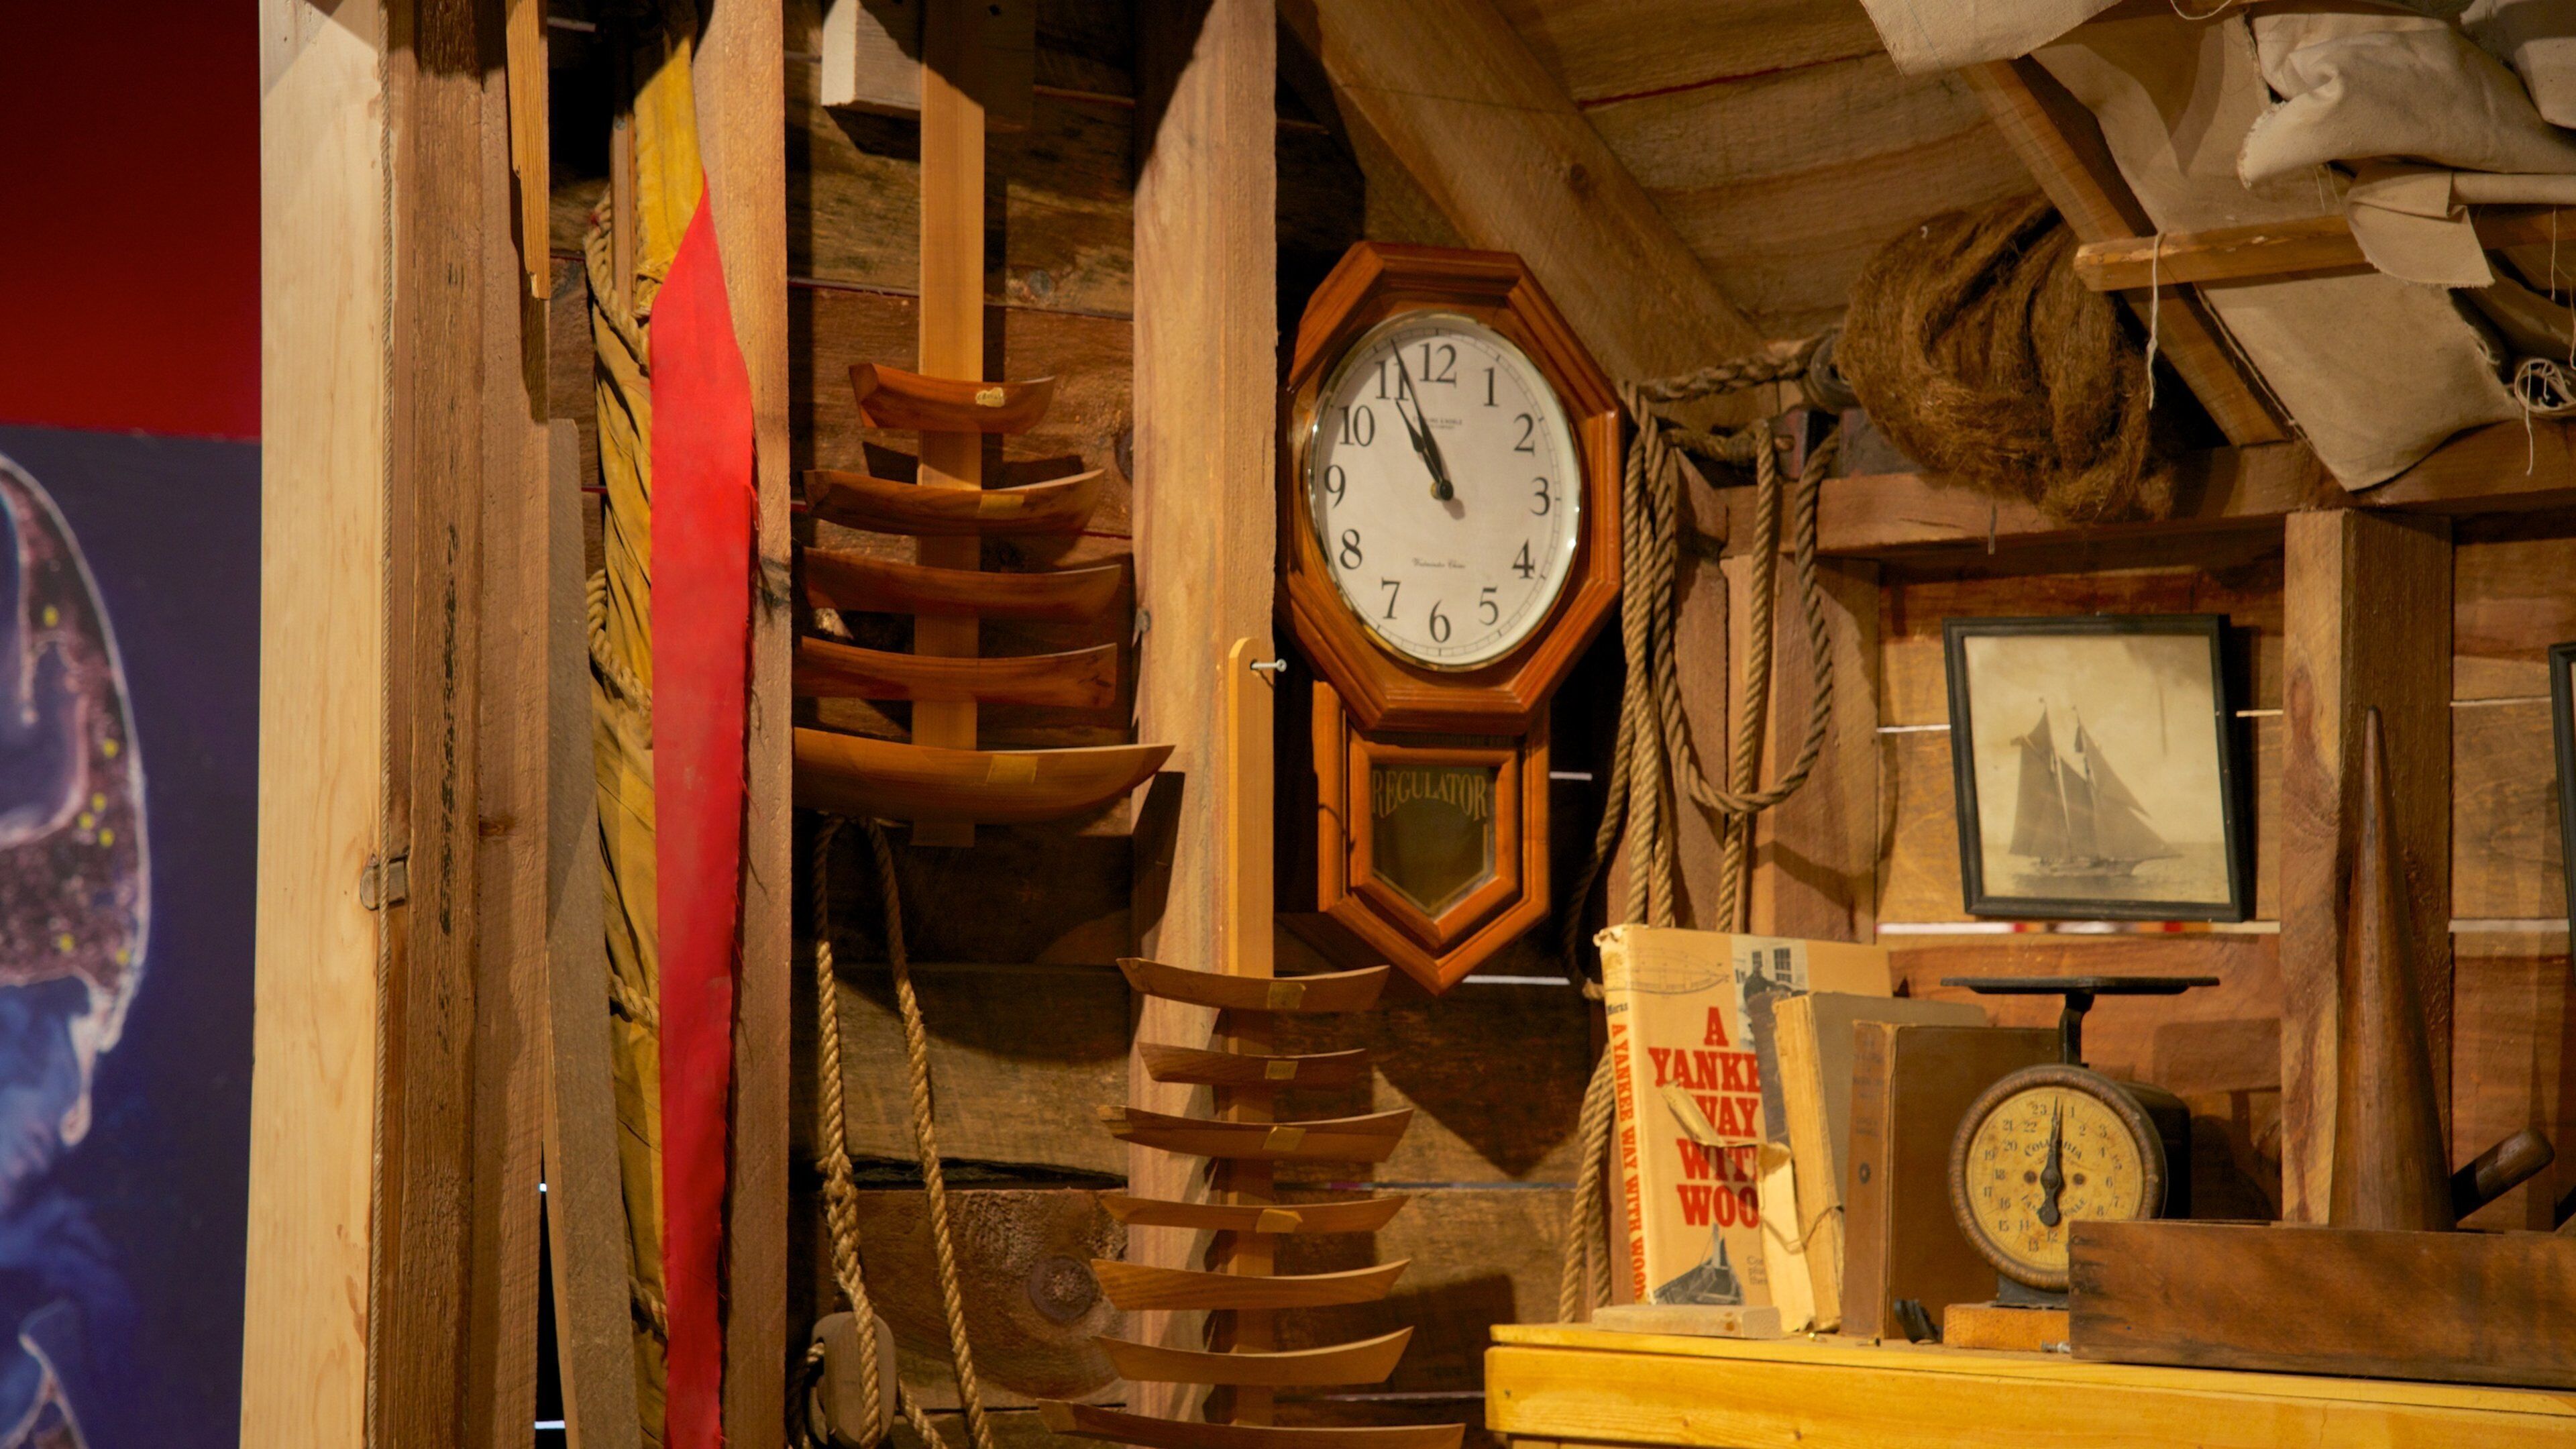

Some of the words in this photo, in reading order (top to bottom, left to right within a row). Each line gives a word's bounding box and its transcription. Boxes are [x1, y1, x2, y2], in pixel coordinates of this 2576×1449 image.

[1375, 360, 1411, 402] 11
[1419, 343, 1457, 386] 12
[1483, 367, 1498, 407] 1
[1338, 405, 1375, 447] 10
[1513, 413, 1535, 455] 2
[1324, 464, 1346, 508] 9
[1530, 477, 1550, 516] 3
[1339, 529, 1363, 570] 8
[1511, 539, 1536, 579] 4
[1381, 578, 1401, 619] 7
[1479, 586, 1499, 625] 5
[1429, 600, 1451, 643] 6
[1373, 770, 1487, 821] REGULATOR
[1611, 1024, 1627, 1038] A
[1704, 1006, 1730, 1047] A
[1613, 1039, 1634, 1122] YANKEE
[1648, 1046, 1762, 1093] YANKE
[2002, 1119, 2013, 1132] 21
[2023, 1120, 2037, 1133] 22
[2032, 1104, 2047, 1115] 23
[2070, 1106, 2075, 1118] 1
[1621, 1125, 1638, 1169] WAY
[2003, 1140, 2018, 1152] 20
[2079, 1124, 2086, 1136] 2
[2099, 1124, 2107, 1138] 3
[1675, 1138, 1758, 1183] WIT
[1984, 1149, 1995, 1161] 19
[1984, 1185, 1992, 1197] 17
[1995, 1169, 2006, 1181] 18
[2106, 1176, 2113, 1189] 6
[1625, 1174, 1642, 1232] WITH
[1676, 1183, 1760, 1229] WOO
[2000, 1197, 2011, 1210] 16
[2097, 1205, 2104, 1217] 8
[2114, 1195, 2120, 1208] 7
[1998, 1220, 2010, 1232] 15
[2028, 1238, 2039, 1252] 13
[2046, 1230, 2058, 1243] 12
